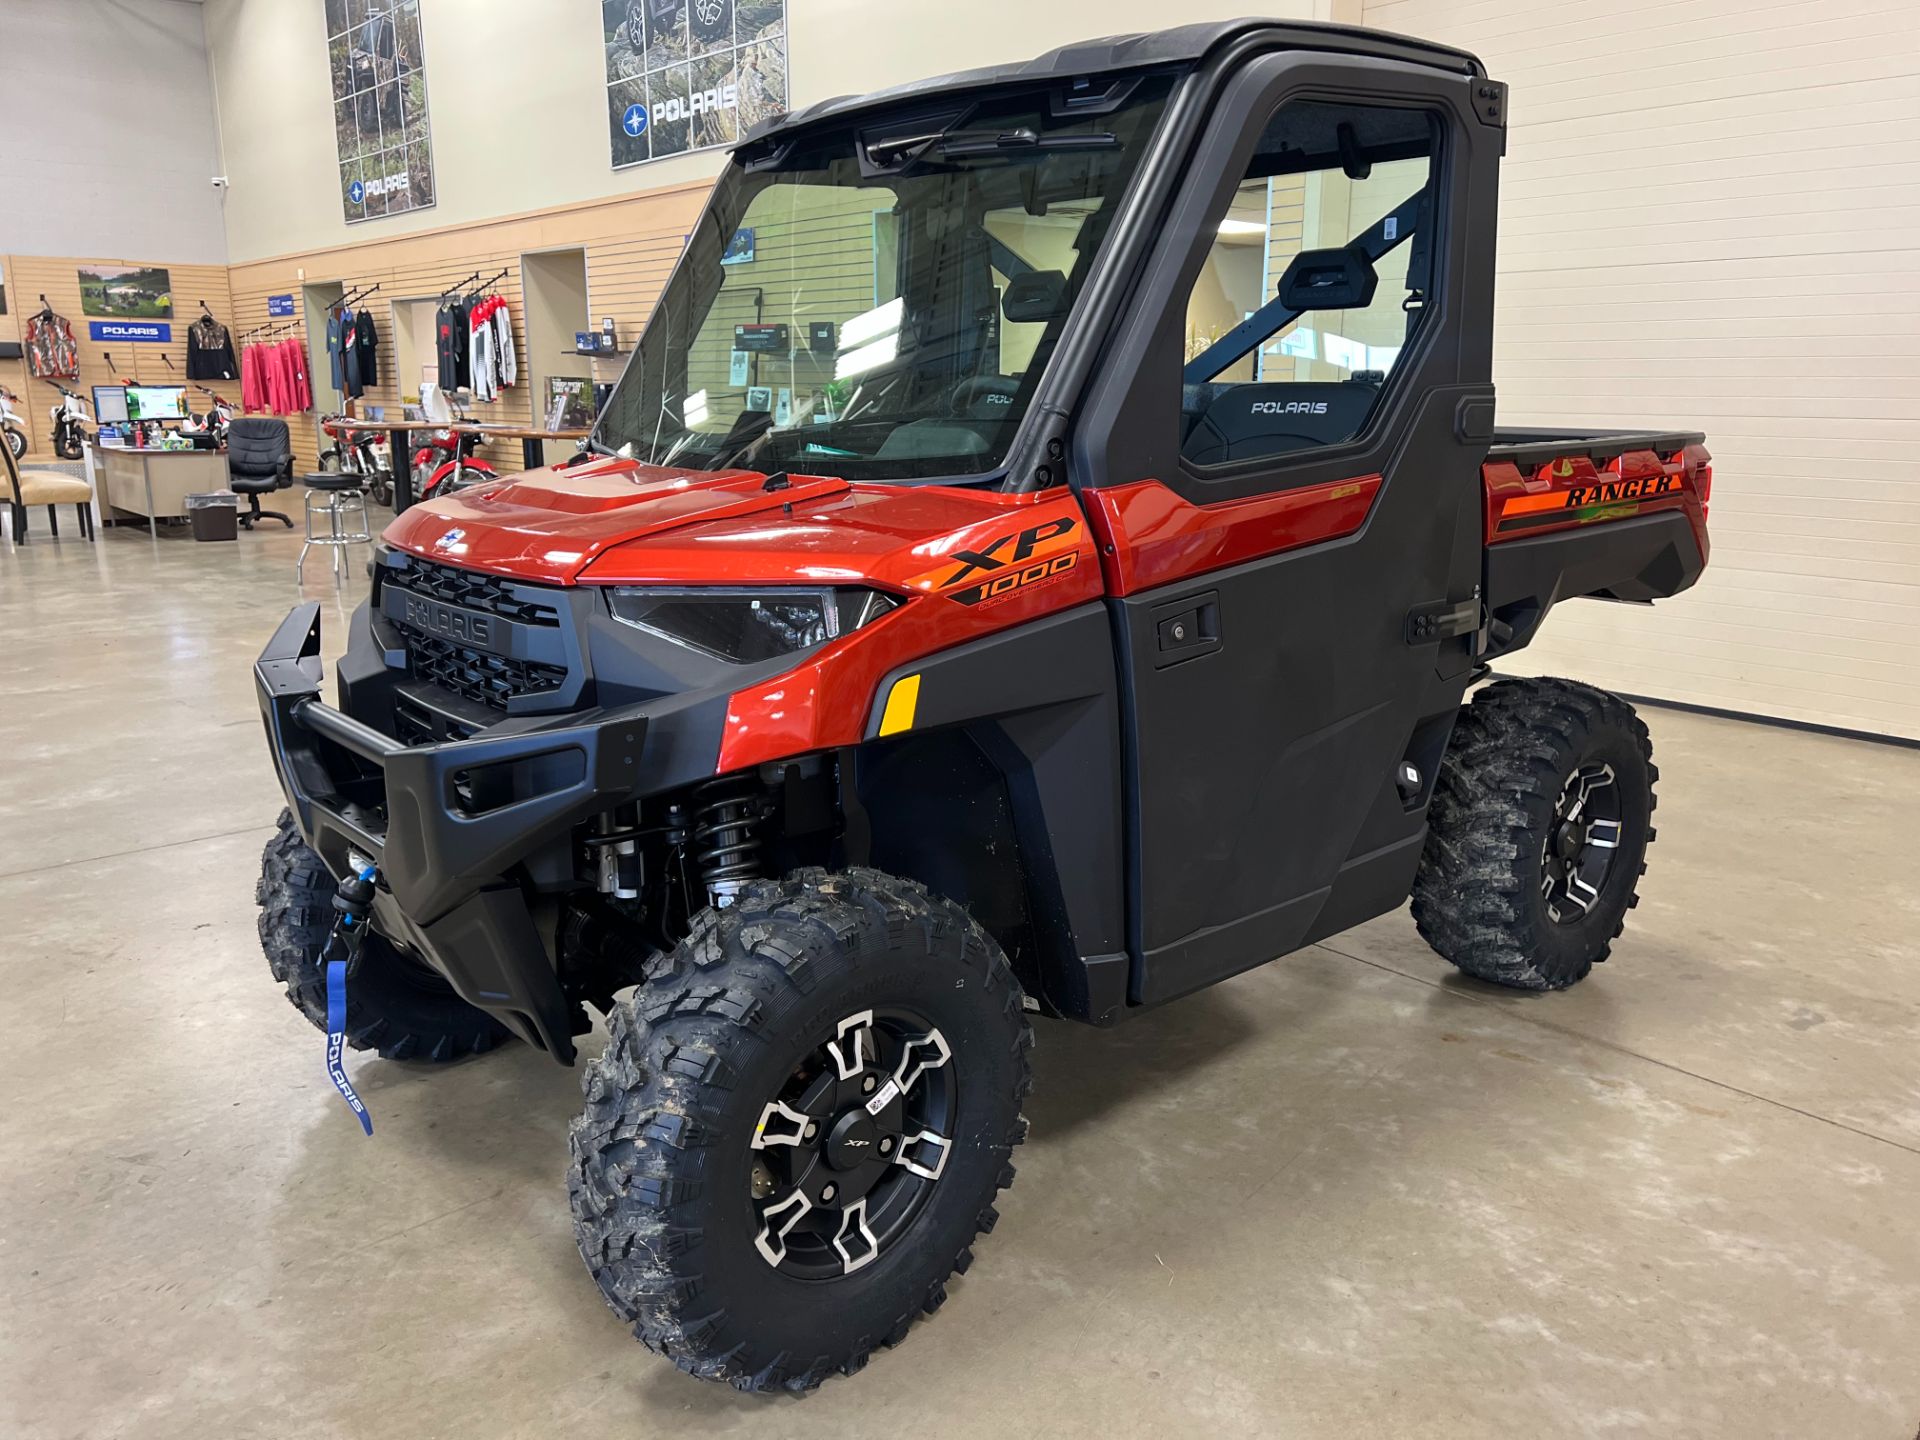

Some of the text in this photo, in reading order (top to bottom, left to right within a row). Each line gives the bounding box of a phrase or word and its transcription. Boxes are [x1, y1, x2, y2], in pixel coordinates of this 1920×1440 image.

[652, 84, 737, 126] POLARIS
[365, 172, 408, 197] POLARIS
[102, 326, 158, 335] POLARIS
[987, 394, 1014, 404] POL
[1250, 402, 1328, 414] POLARIS
[1565, 475, 1673, 508] RANGER
[938, 517, 1077, 589] XP
[979, 552, 1078, 600] 1000
[406, 601, 489, 646] POLARIS
[329, 1032, 364, 1113] POLARIS
